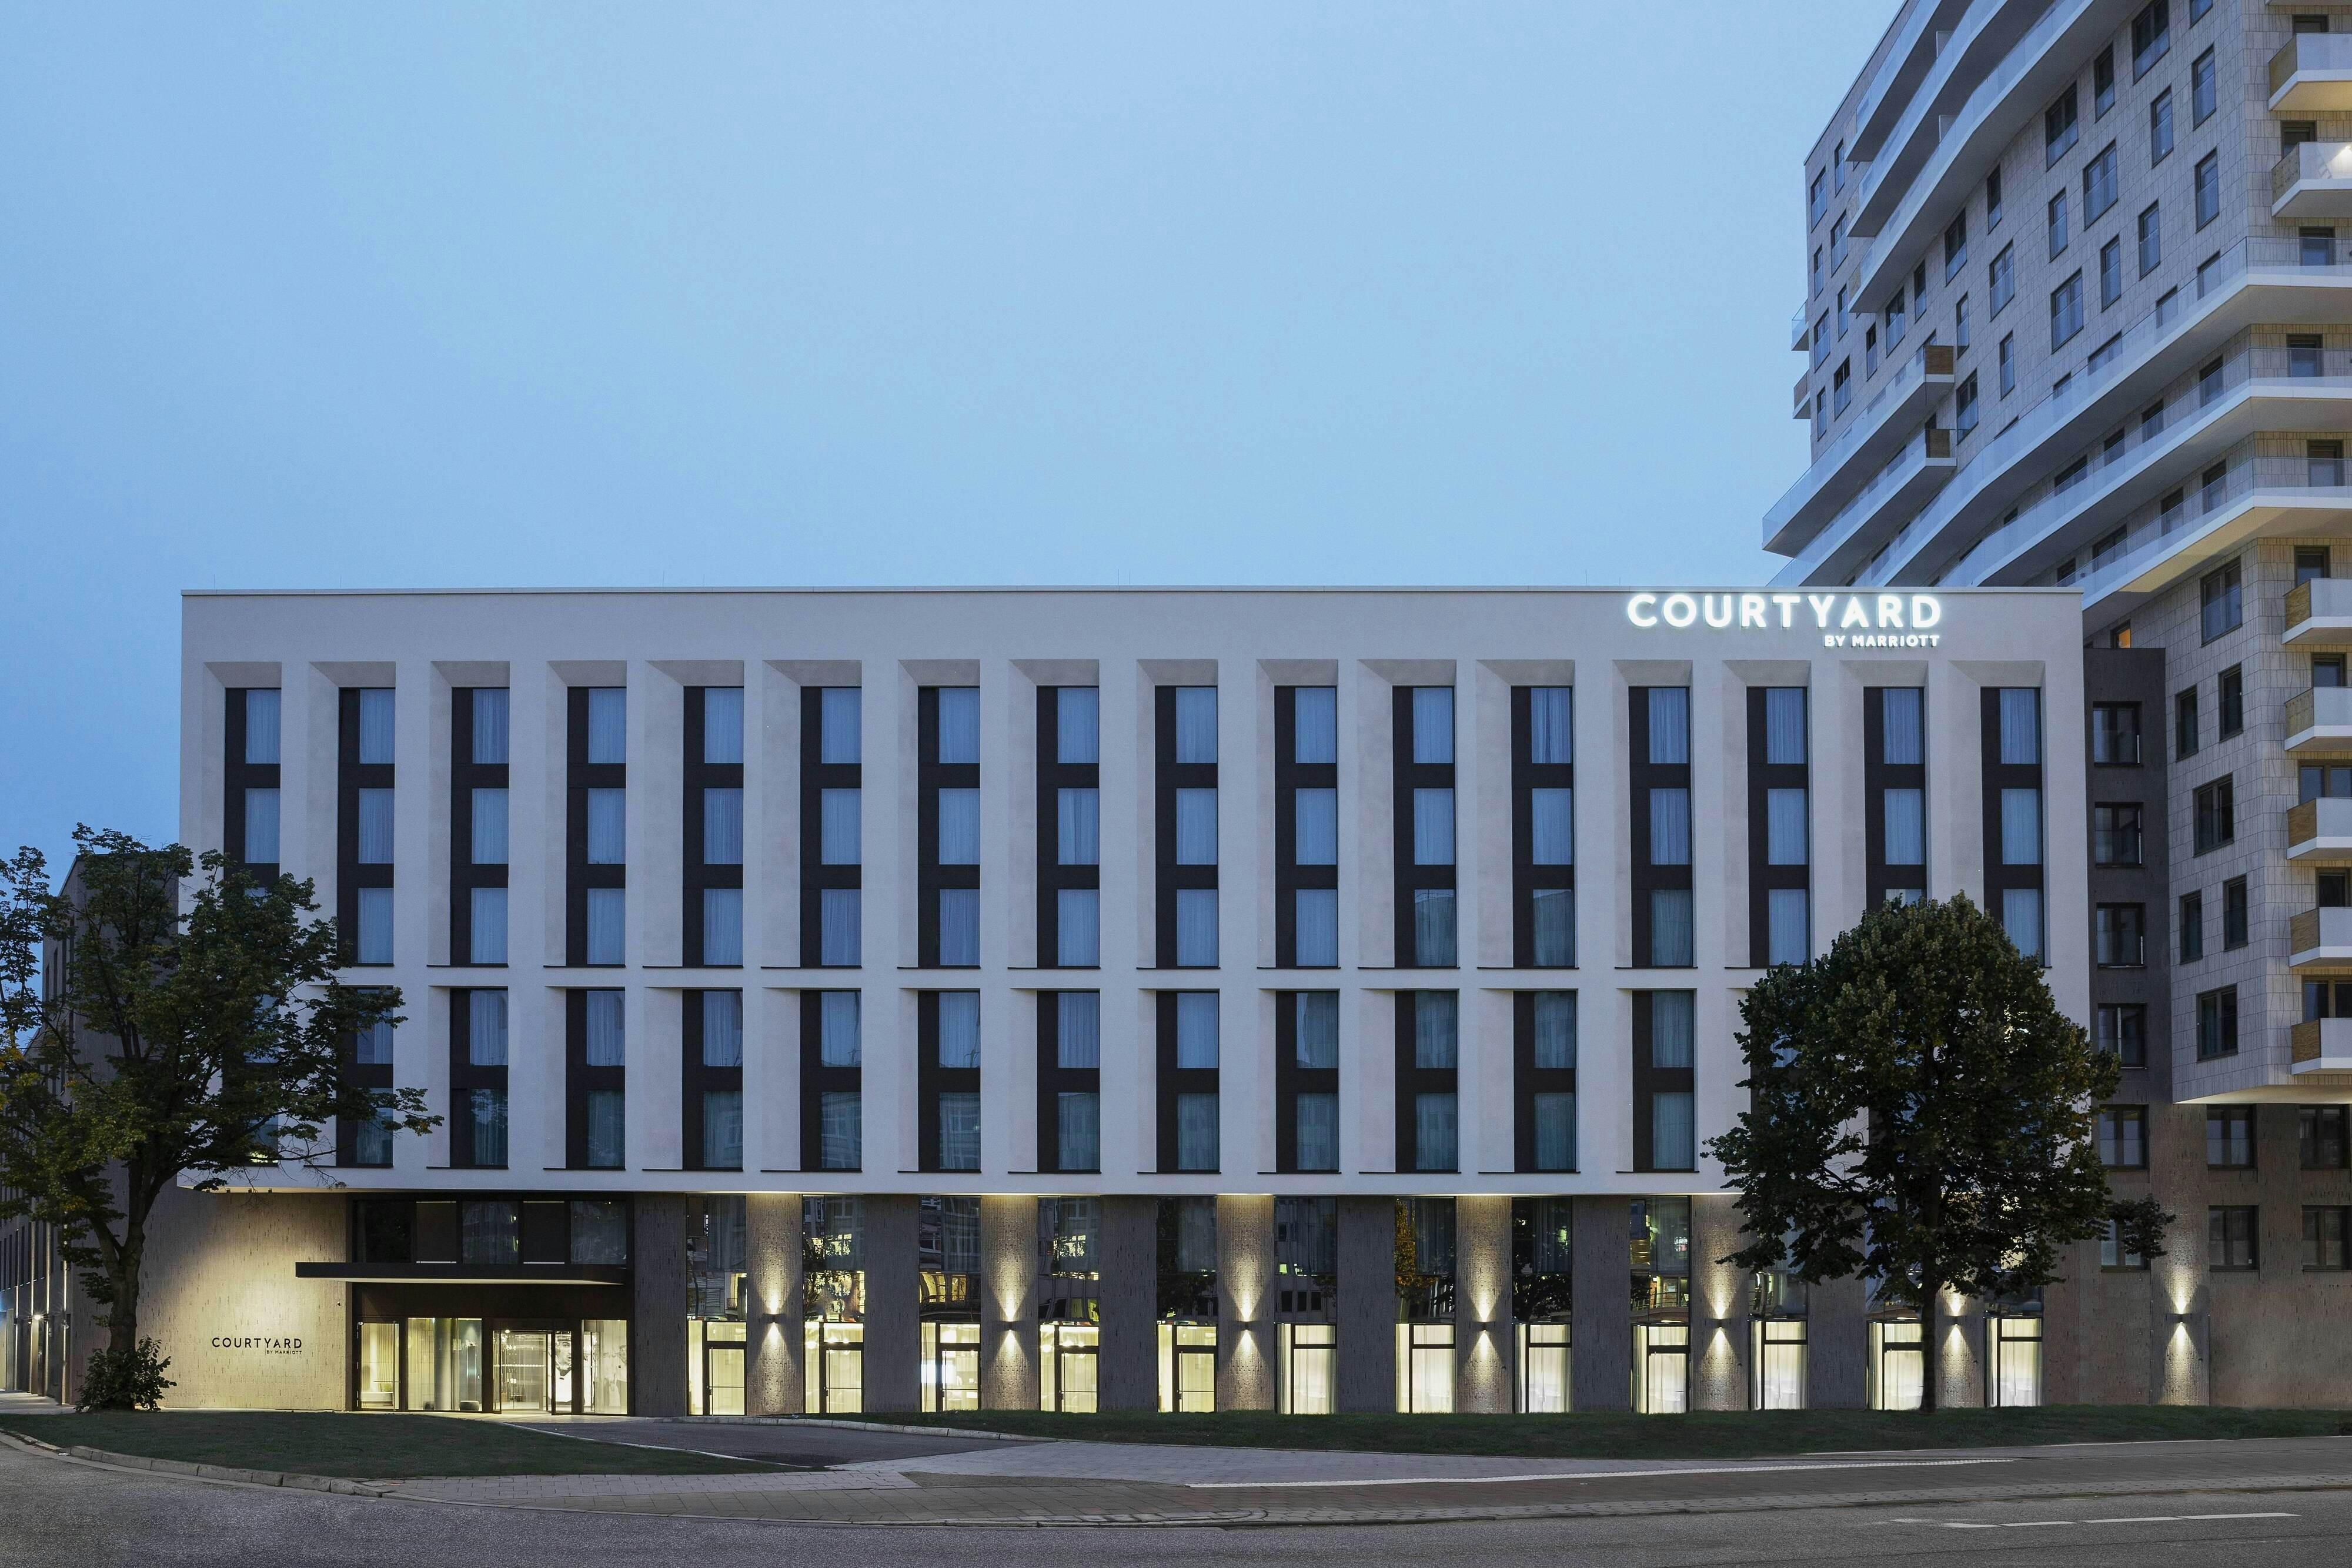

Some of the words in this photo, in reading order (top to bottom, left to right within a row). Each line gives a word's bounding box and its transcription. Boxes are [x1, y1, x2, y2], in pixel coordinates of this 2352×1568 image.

[1628, 594, 1941, 627] COURTYARD
[1825, 635, 1846, 647] BY
[1852, 635, 1940, 647] MARRIOTT
[212, 1337, 302, 1349] COURTYARD
